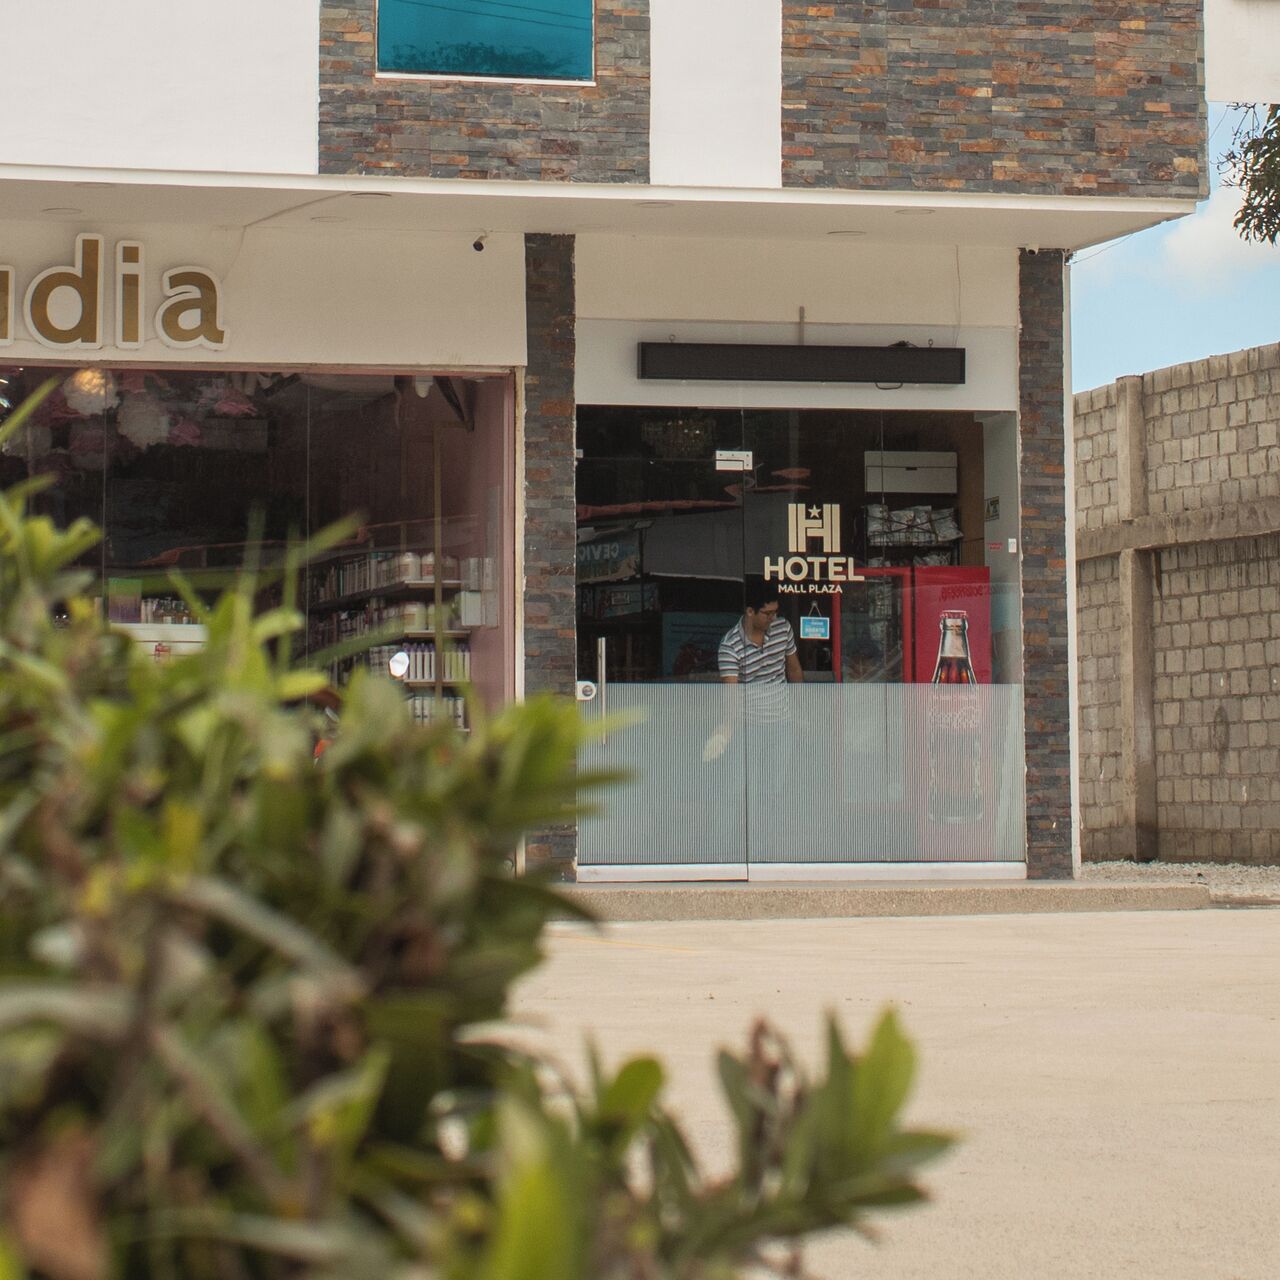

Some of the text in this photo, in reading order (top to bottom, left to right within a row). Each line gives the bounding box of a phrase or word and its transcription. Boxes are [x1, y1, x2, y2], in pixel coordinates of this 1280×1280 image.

[764, 556, 865, 581] HOTEL
[778, 584, 843, 594] MALL PLAZA
